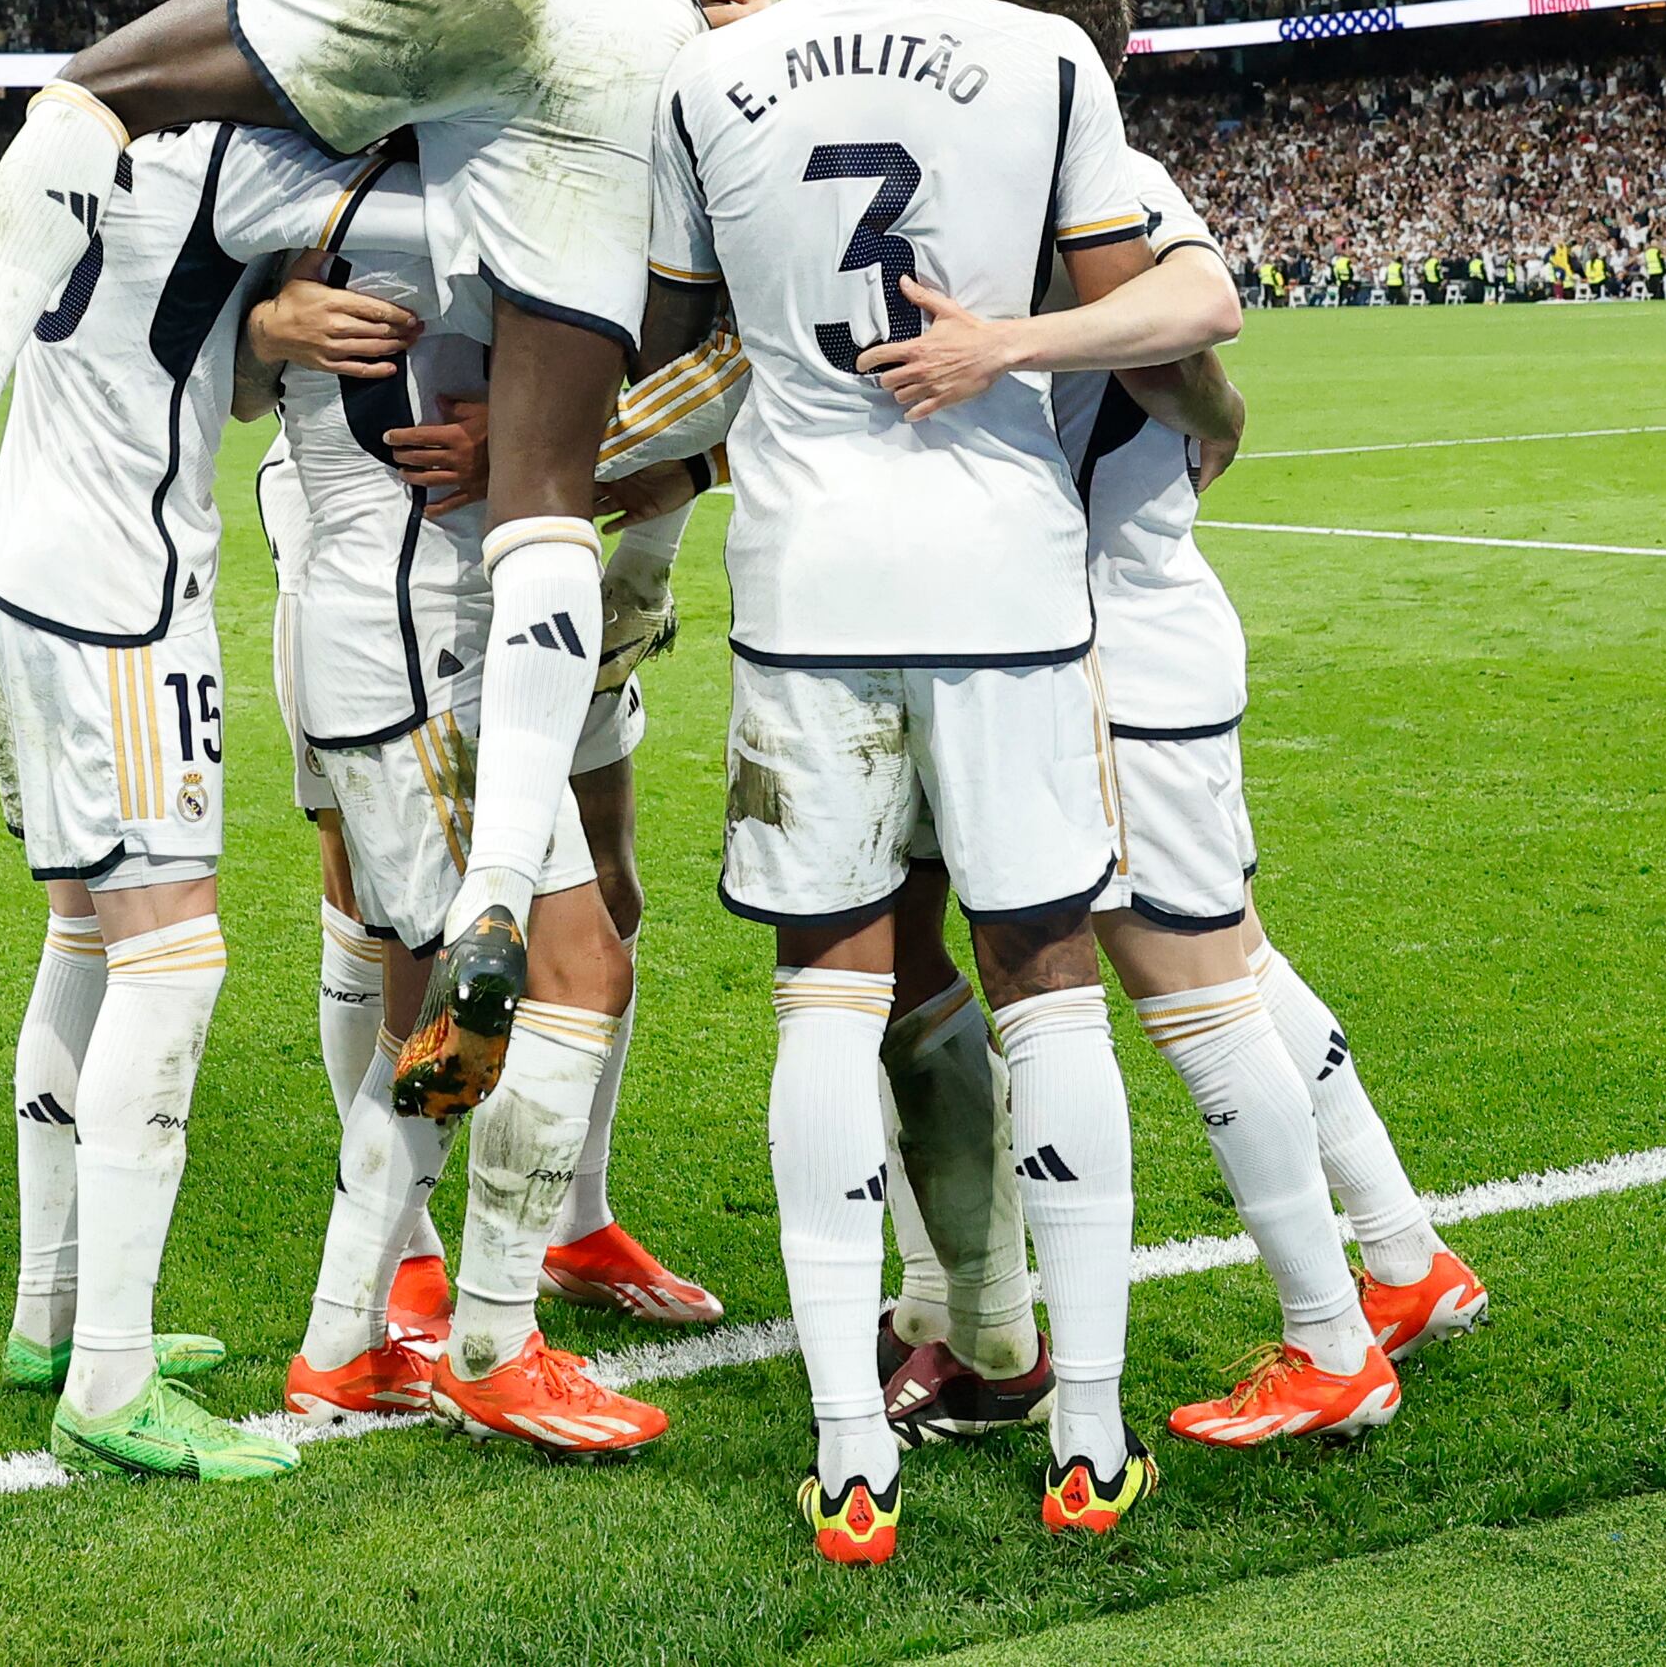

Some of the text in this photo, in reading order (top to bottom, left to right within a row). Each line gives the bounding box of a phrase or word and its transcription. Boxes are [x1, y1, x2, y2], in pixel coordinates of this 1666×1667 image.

[1279, 6, 1403, 42] GOOOOOOL
[726, 33, 989, 123] E. MILITÃO
[802, 142, 923, 375] 3
[164, 673, 222, 764] 15
[320, 981, 380, 1003] RMCF
[147, 1113, 189, 1131] RM
[1201, 1110, 1238, 1127] CF
[526, 1168, 576, 1183] RM
